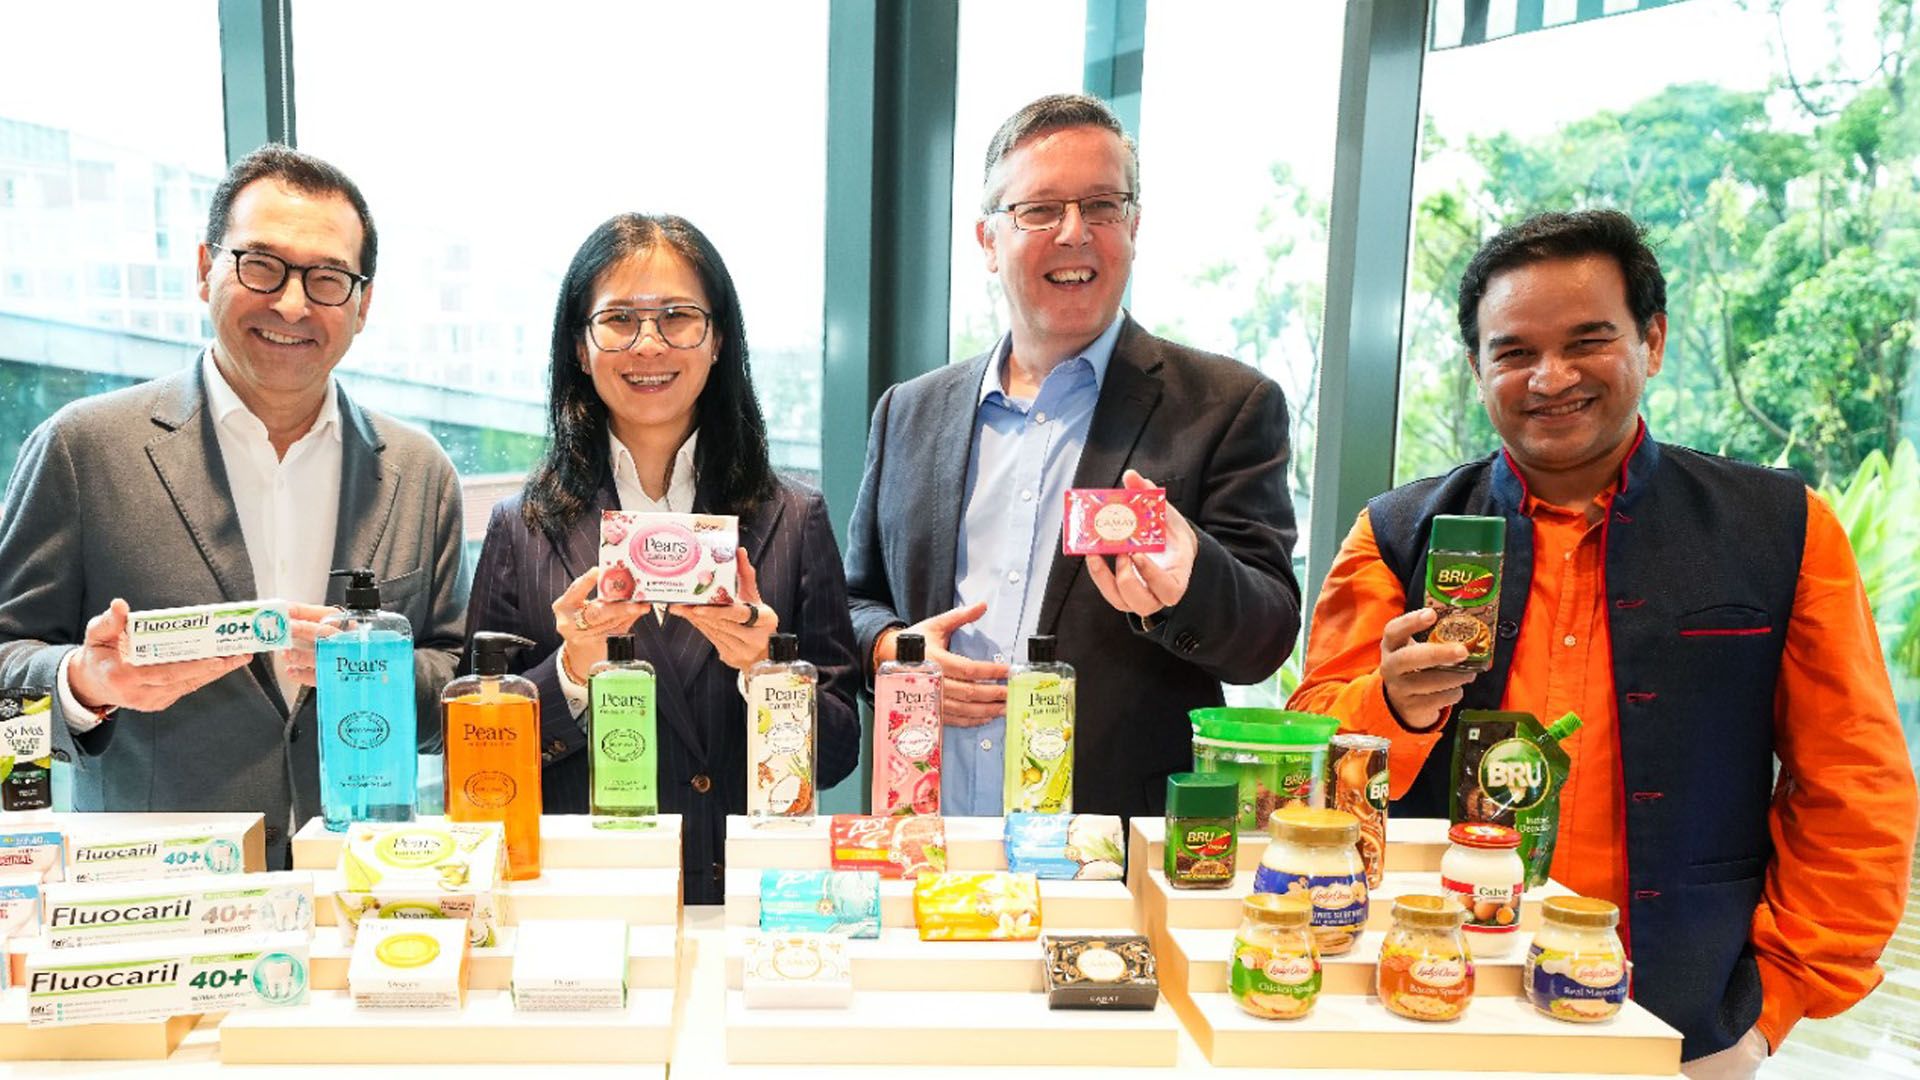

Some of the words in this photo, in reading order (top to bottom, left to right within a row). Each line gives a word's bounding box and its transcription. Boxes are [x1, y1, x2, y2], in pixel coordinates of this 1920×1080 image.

[644, 538, 688, 554] Pears
[1438, 569, 1472, 584] BRU
[134, 614, 210, 633] Fluocaril
[215, 621, 251, 636] 40+
[336, 656, 388, 673] Pears
[602, 693, 647, 708] Pears
[765, 687, 807, 702] Pears
[896, 690, 938, 704] Pears
[1028, 692, 1069, 707] Pears
[464, 723, 518, 741] Pears
[1487, 761, 1543, 788] BRU
[1369, 785, 1389, 800] BR
[1187, 831, 1215, 843] BRU
[76, 843, 158, 862] Fluocaril
[163, 850, 201, 866] 40+
[51, 899, 192, 928] Fluocaril
[201, 903, 258, 924] 40+
[30, 962, 180, 993] Fluocaril
[188, 967, 248, 990] 40+
[1563, 986, 1584, 996] Real
